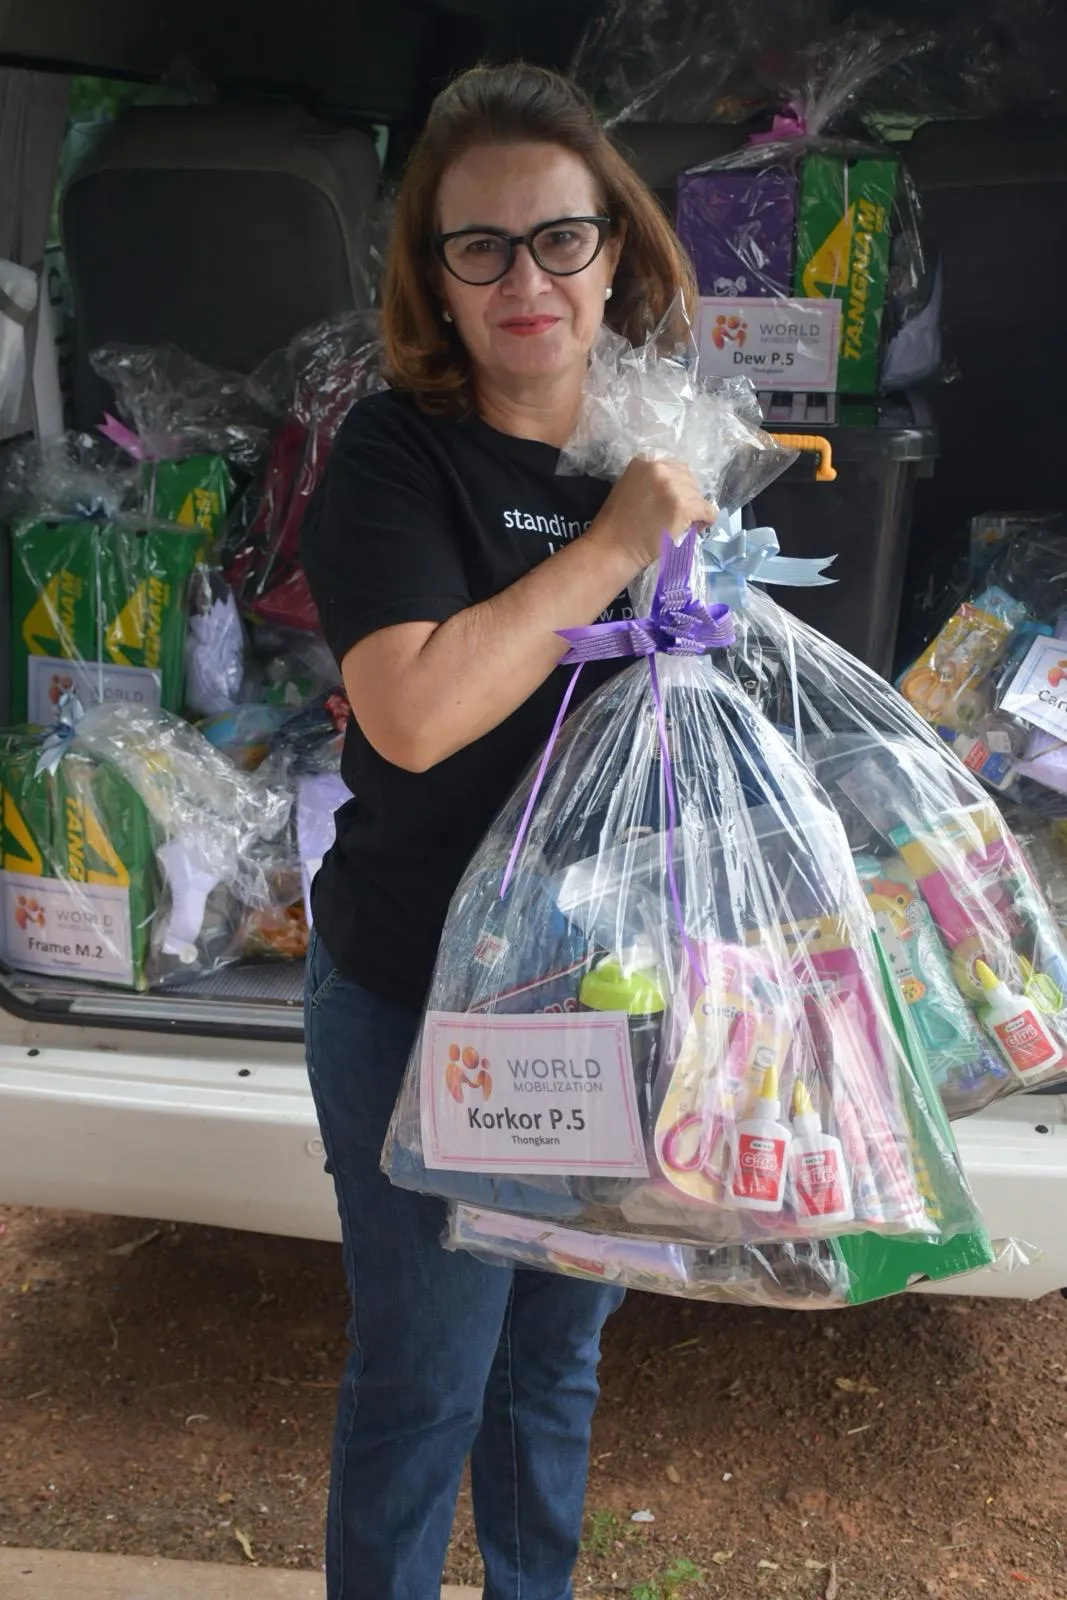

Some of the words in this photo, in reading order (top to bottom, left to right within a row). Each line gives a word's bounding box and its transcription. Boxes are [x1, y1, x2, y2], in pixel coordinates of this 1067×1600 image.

[760, 323, 820, 337] WORLD
[733, 351, 766, 364] Dew
[772, 352, 795, 366] P.5
[28, 937, 71, 955] Frame
[75, 944, 104, 959] M.2
[507, 1059, 601, 1079] WORLD
[513, 1081, 604, 1093] MOBILIZATION
[467, 1107, 543, 1130] Korkor
[549, 1108, 586, 1131] P.5
[512, 1135, 561, 1147] Thongkarn
